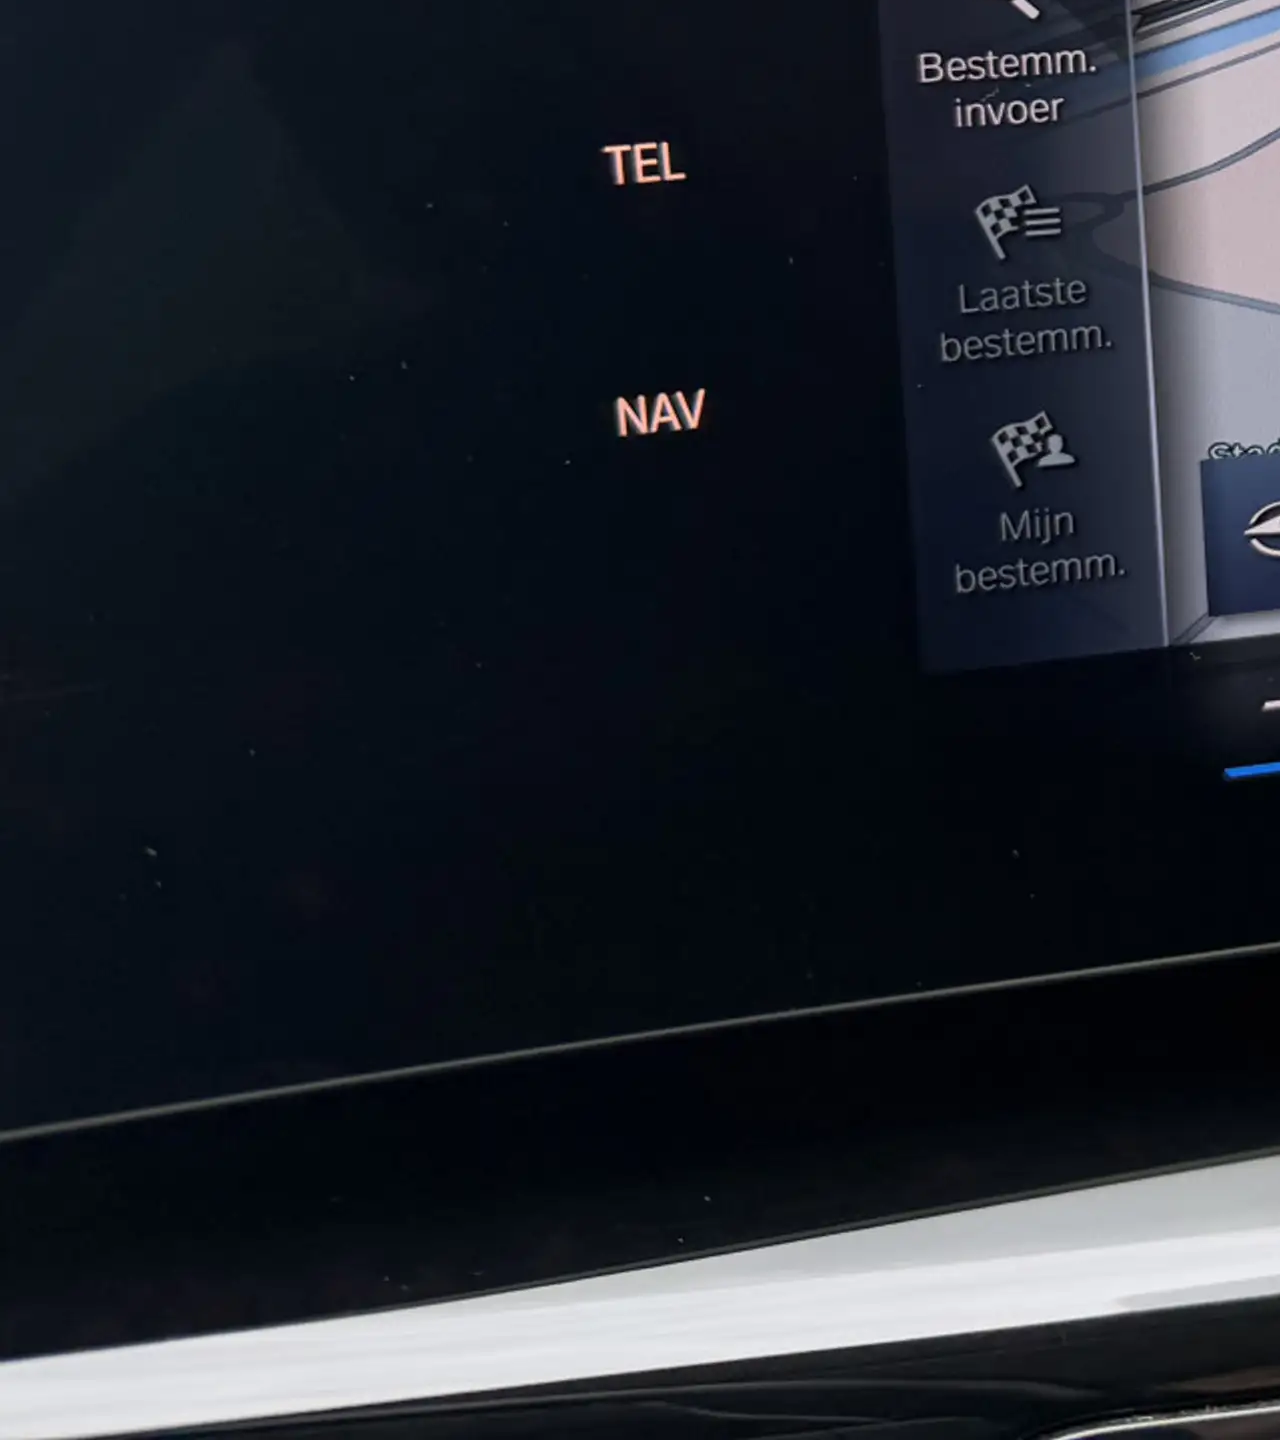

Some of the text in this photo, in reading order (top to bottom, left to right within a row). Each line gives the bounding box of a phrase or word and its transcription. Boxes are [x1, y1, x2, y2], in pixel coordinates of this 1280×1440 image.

[918, 48, 1097, 83] Bestemm.
[955, 94, 1063, 128] invoer
[603, 142, 686, 185] TEL
[959, 275, 1087, 314] Laatste
[941, 320, 1112, 361] bestemm.
[614, 389, 705, 436] NAV
[1001, 507, 1075, 545] Mijn
[956, 551, 1125, 594] bestemm.
